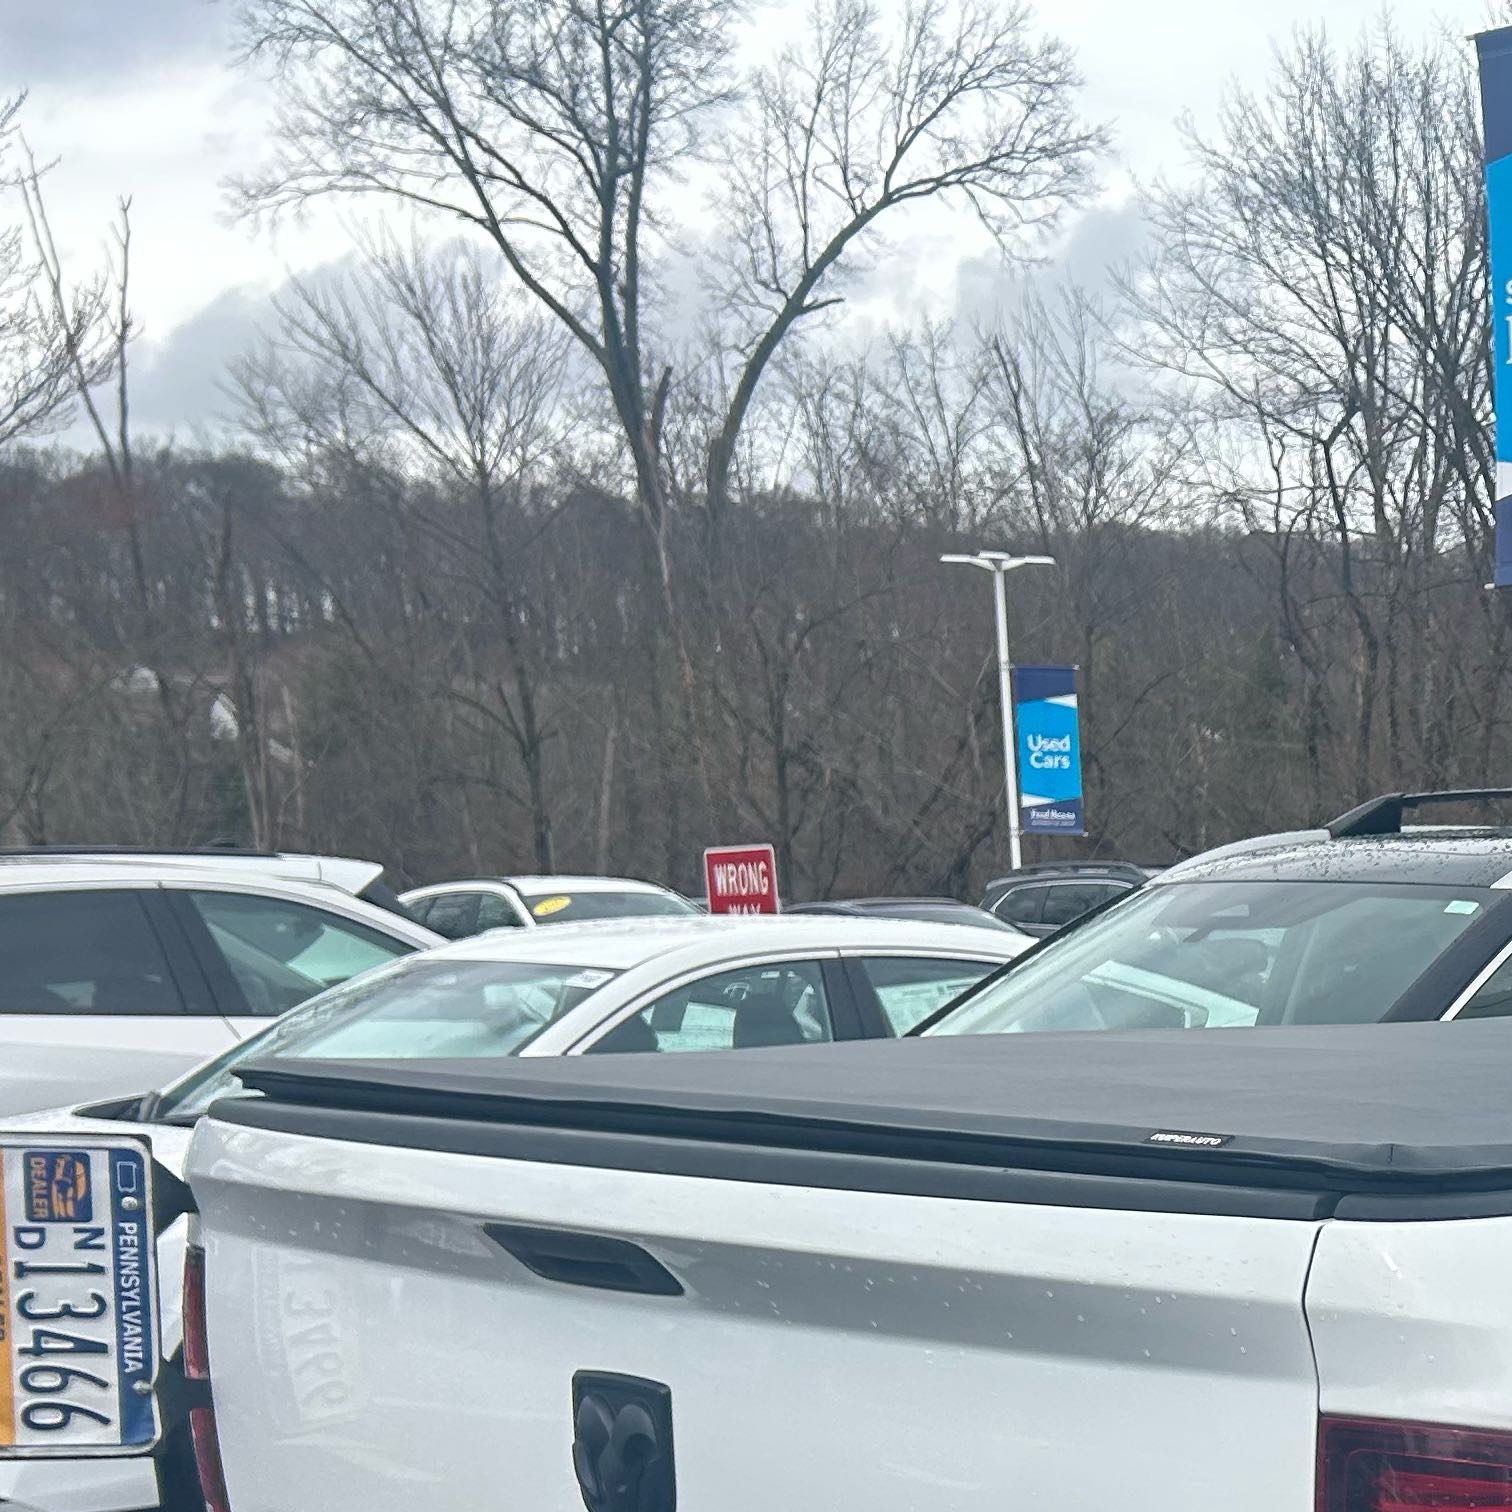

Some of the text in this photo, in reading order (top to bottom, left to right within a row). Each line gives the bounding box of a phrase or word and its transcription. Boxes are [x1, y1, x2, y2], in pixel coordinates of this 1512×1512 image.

[1027, 733, 1070, 752] Used
[1029, 751, 1070, 769] Cars
[713, 861, 769, 897] WRONG
[29, 1156, 50, 1220] DEALER
[73, 1226, 106, 1250] N
[118, 1221, 144, 1374] PENNSYLVANIA
[13, 1259, 113, 1431] 13466
